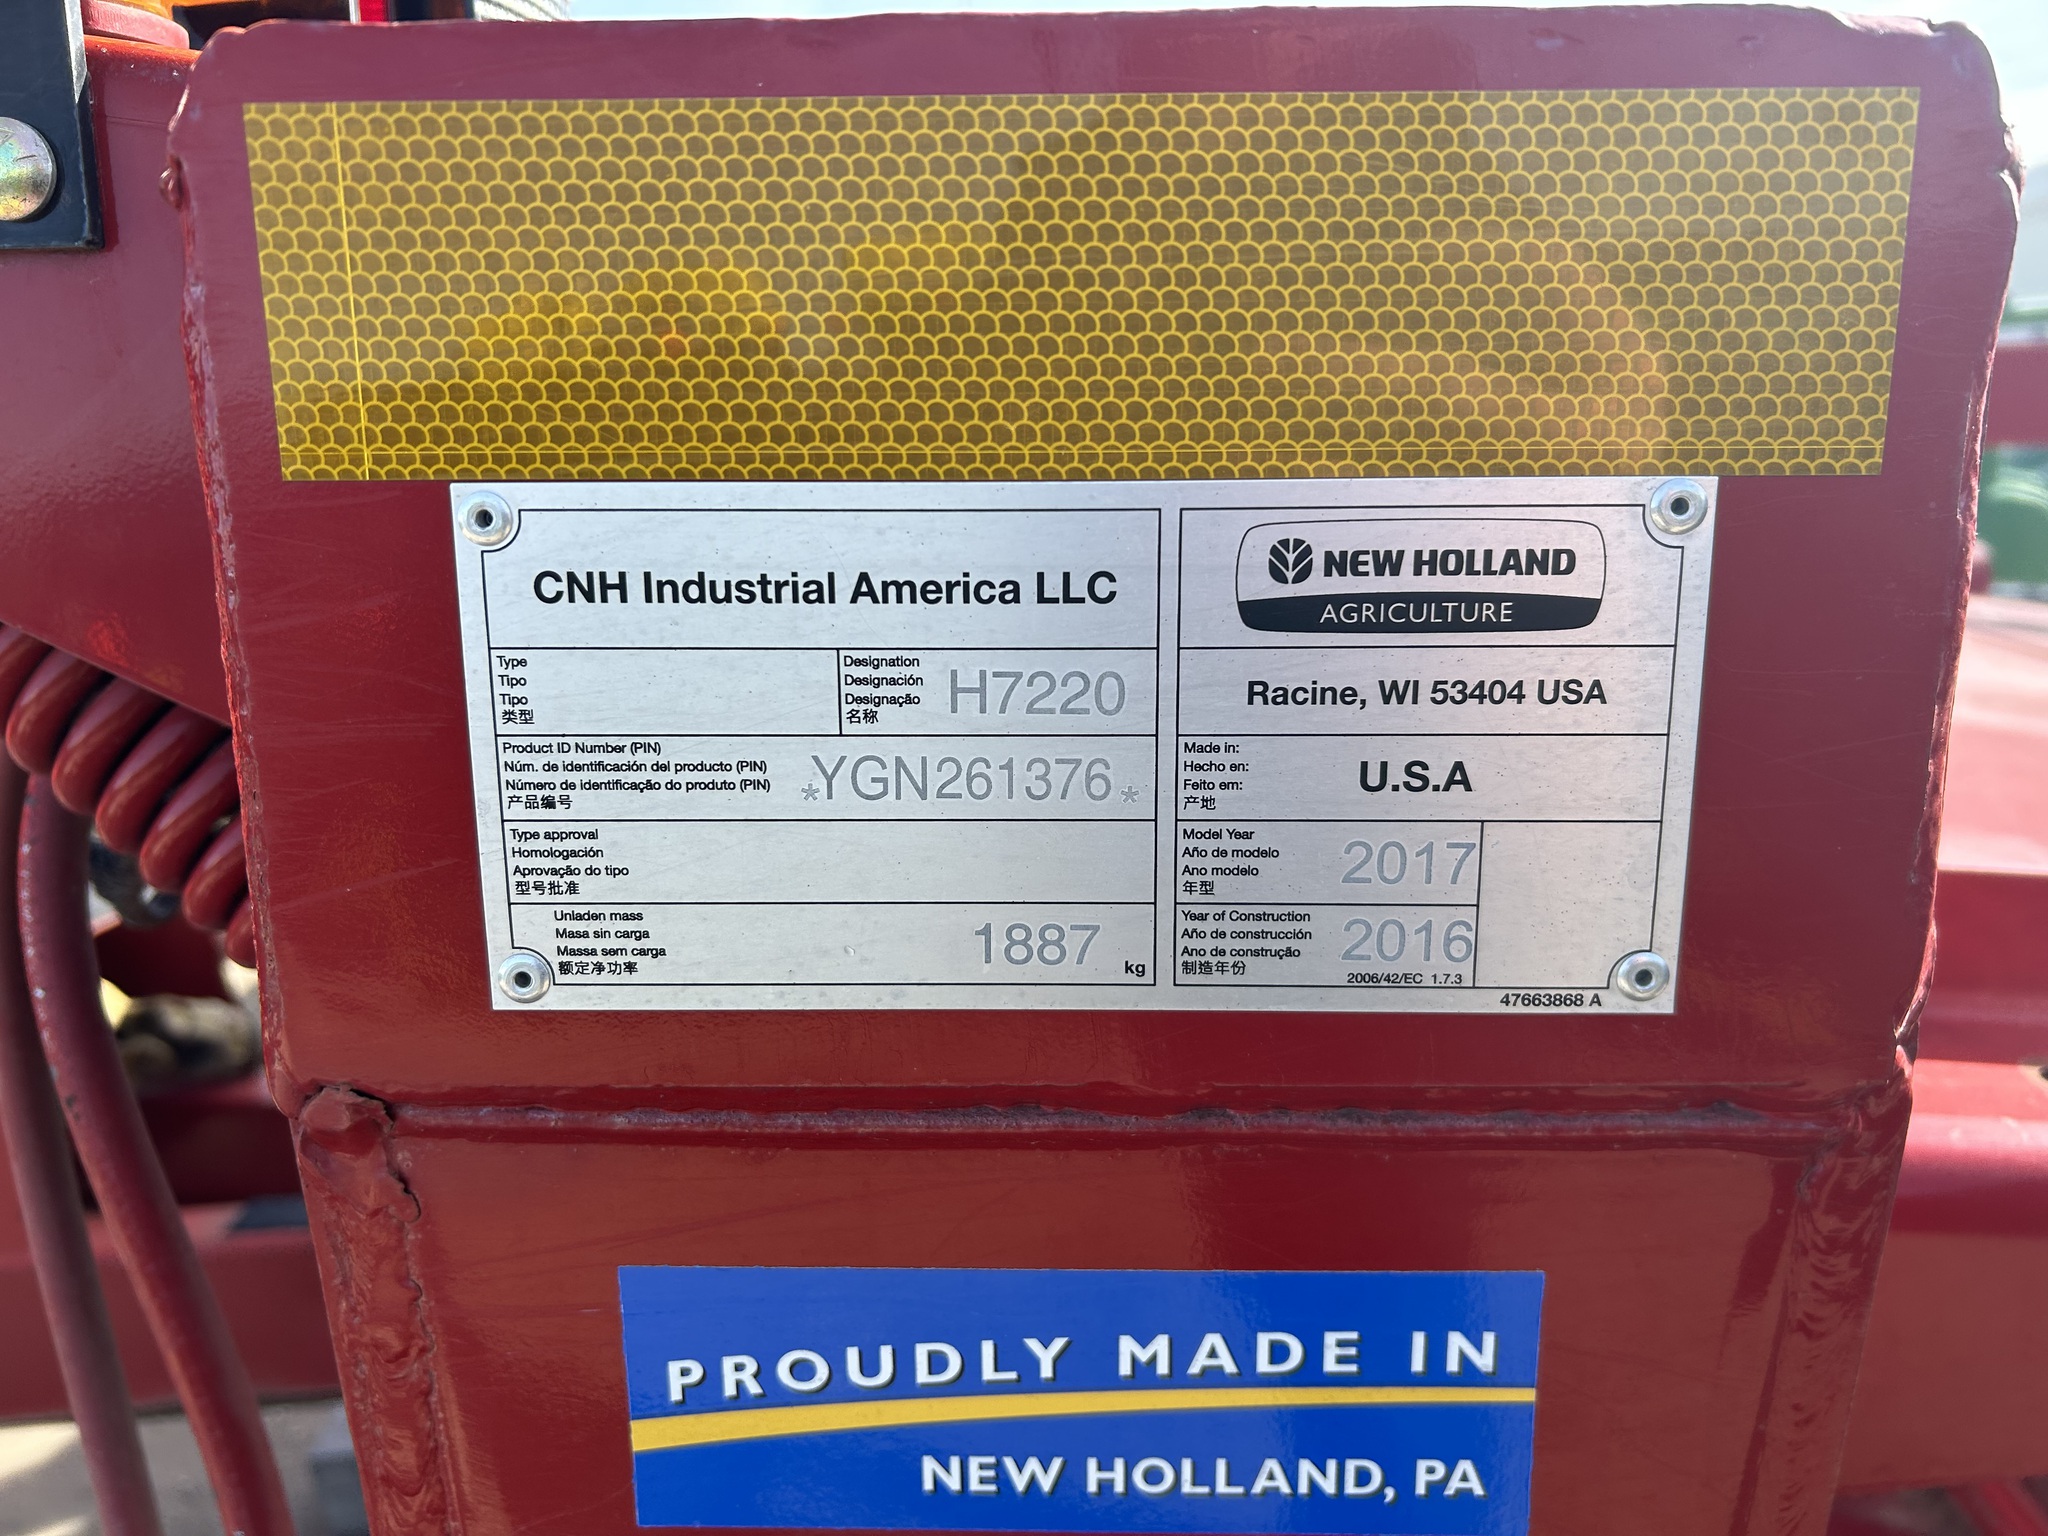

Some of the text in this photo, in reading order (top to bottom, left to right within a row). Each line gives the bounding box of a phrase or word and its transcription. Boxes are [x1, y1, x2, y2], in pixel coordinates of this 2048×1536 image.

[1324, 549, 1576, 577] NEW HOLLAND
[534, 571, 1116, 604] CNH Industrial America LLC
[1320, 603, 1513, 622] AGRICULTURE
[496, 656, 527, 670] Type
[844, 656, 919, 669] Designation
[498, 675, 526, 688] Tipo
[845, 672, 923, 688] Designación
[951, 670, 1125, 716] H7220
[1248, 679, 1607, 710] Racine, WI 53404 USA
[499, 694, 528, 707] Tipo
[845, 693, 920, 710] Designação
[502, 709, 534, 724] 类型
[847, 709, 878, 724] 名称
[503, 742, 661, 756] Product ID Number (PIN)
[1184, 742, 1239, 753] Made in:
[505, 761, 766, 774] Núm. de identificación del producto (PIN)
[1184, 761, 1249, 772] Hecho en:
[1360, 761, 1472, 792] U.S.A
[506, 779, 770, 793] Número de identificação do produto (PIN)
[1184, 779, 1243, 790] Feito em:
[508, 795, 572, 809] 产品编号
[1184, 795, 1216, 810] 产地
[510, 829, 598, 842] Type approval
[1183, 829, 1255, 839] Model Year
[512, 847, 603, 860] Homologación
[1182, 847, 1279, 858] Año de modelo
[1341, 840, 1477, 885] 2017
[513, 865, 629, 878] Aprovação do tipo
[1182, 865, 1259, 876] Ano modelo
[515, 881, 580, 895] 型号批准
[1183, 880, 1215, 895] 年型
[554, 910, 643, 921] Unladen mass
[1182, 910, 1310, 921] Year of Construction
[556, 928, 650, 941] Masa sin carga
[1181, 928, 1311, 939] Año de construcción
[1341, 918, 1473, 963] 2016
[557, 946, 667, 959] Massa sem carga
[975, 924, 1100, 967] 1887
[1181, 946, 1301, 960] Ano de construção
[559, 961, 638, 975] 额定净功率
[1125, 961, 1145, 977] kg
[1182, 960, 1246, 975] 制造年份
[1347, 972, 1463, 985] 2006/42/EC 1.7.3
[1500, 993, 1601, 1006] 47663868 A
[667, 1332, 1495, 1402] PROUDLY MADE IN
[923, 1456, 1484, 1502] NEW HOLLAND, PA
